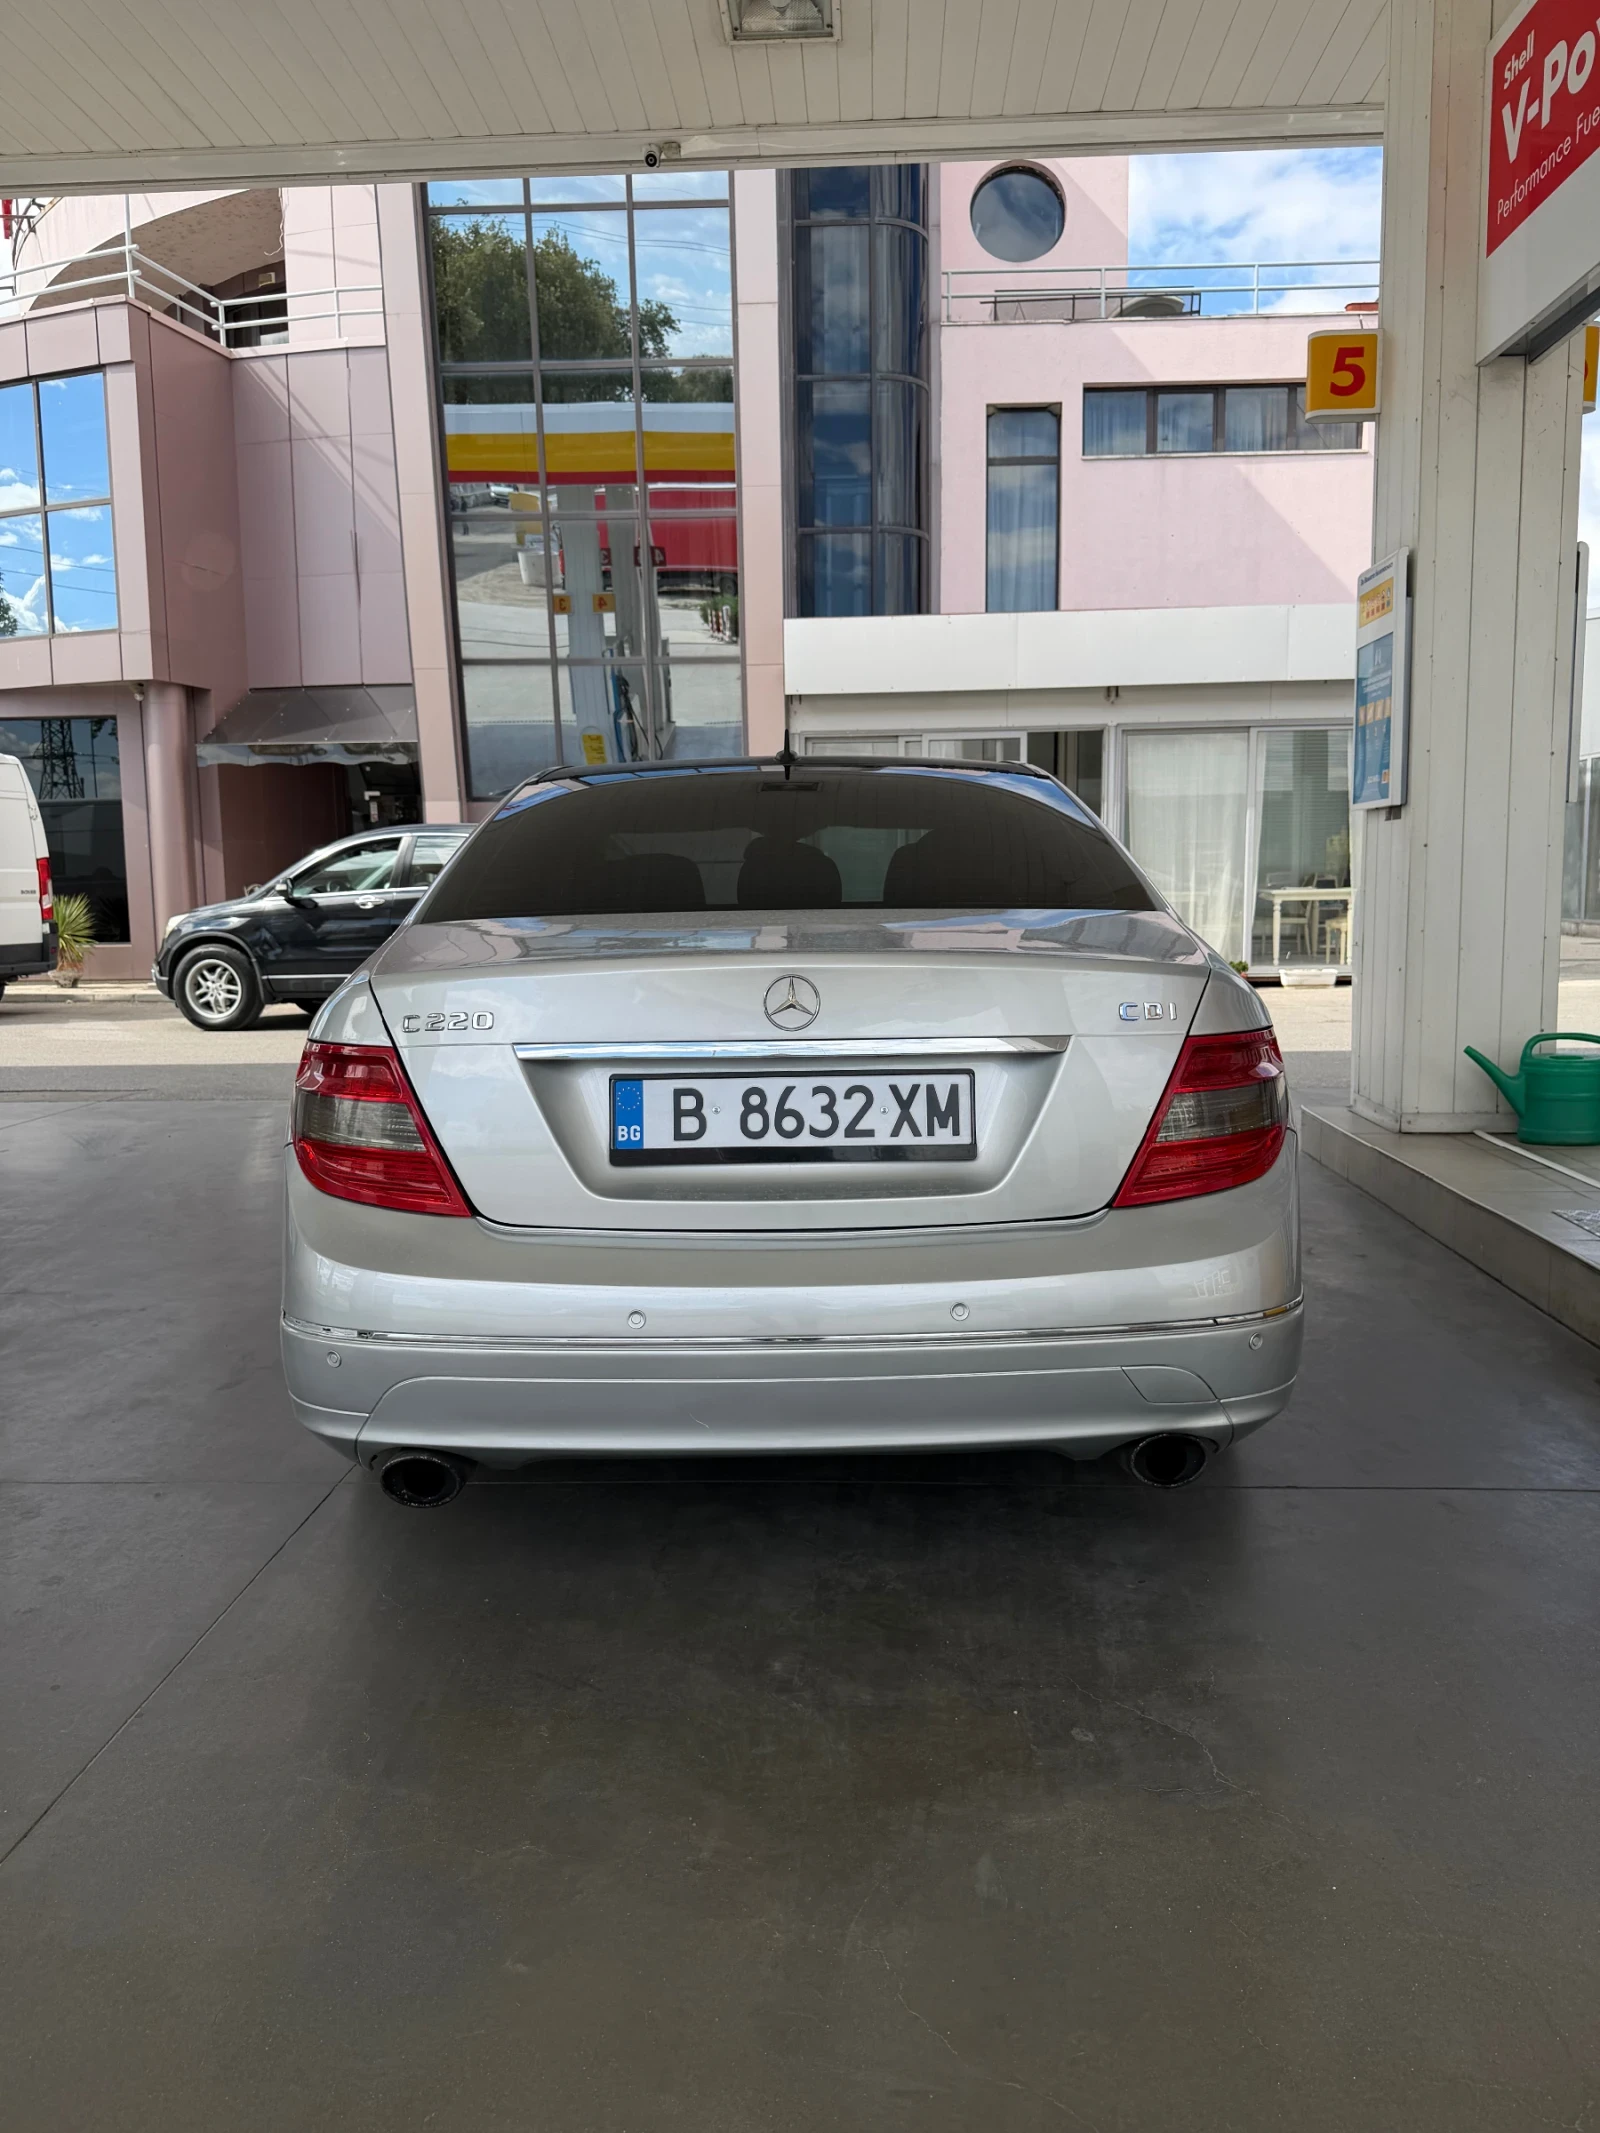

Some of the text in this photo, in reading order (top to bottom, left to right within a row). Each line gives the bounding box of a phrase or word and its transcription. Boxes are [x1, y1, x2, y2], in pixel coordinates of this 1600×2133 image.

[1503, 29, 1535, 90] Shell
[1501, 17, 1600, 164] V-Po
[1497, 135, 1572, 225] Performance
[1329, 346, 1367, 397] 5
[1118, 1002, 1178, 1021] CDI
[617, 1124, 641, 1141] BG
[672, 1083, 962, 1142] B 8632 XM
